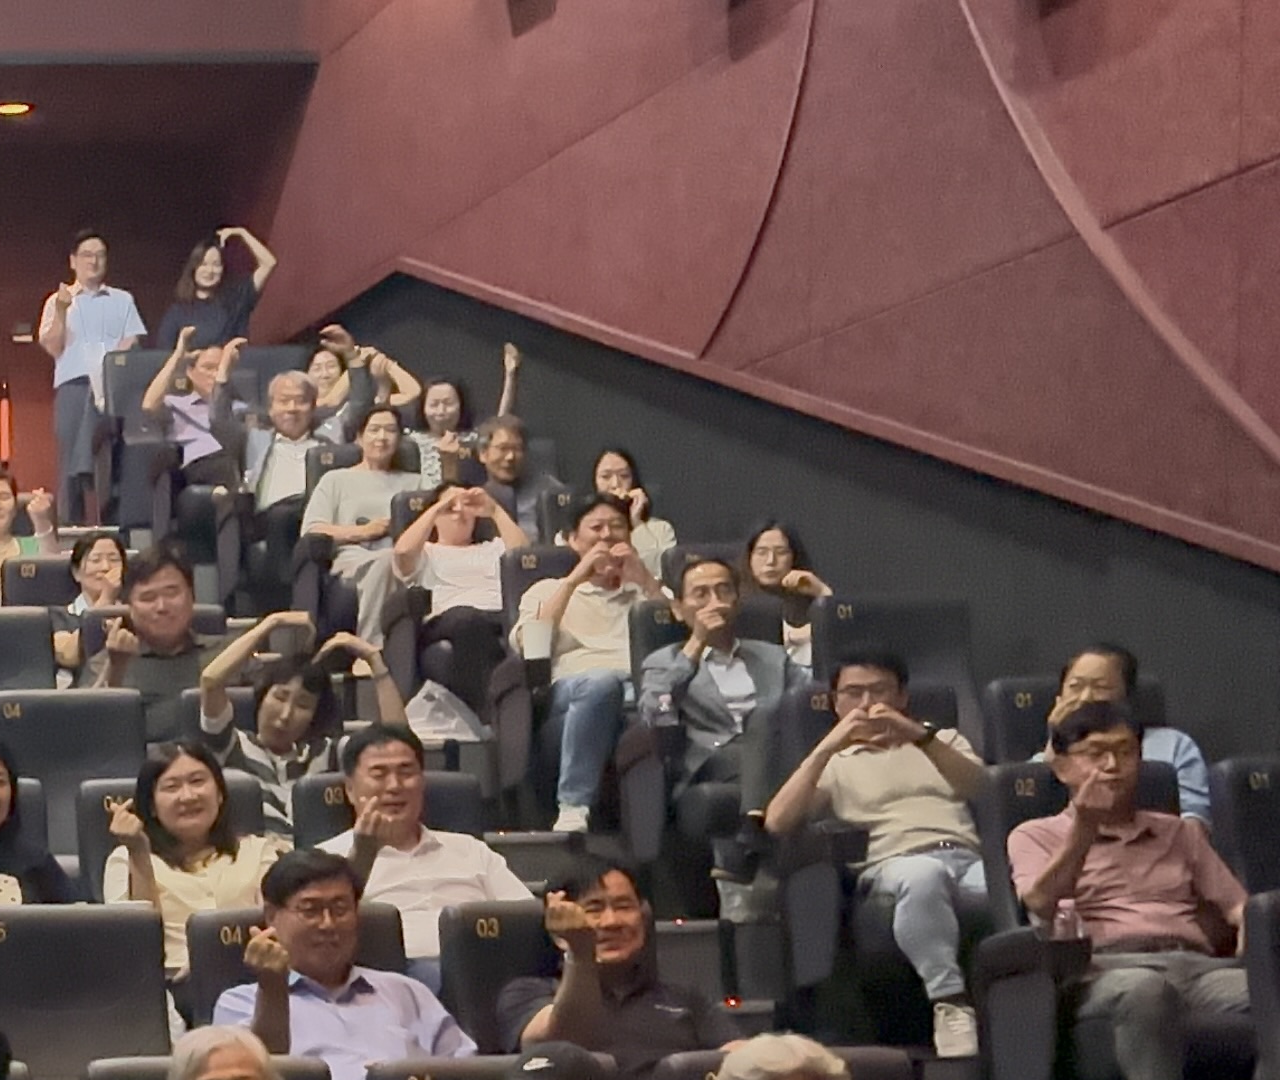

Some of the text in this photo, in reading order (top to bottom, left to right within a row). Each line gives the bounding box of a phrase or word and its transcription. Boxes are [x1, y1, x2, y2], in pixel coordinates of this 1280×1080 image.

[2, 701, 21, 719] 04
[1013, 777, 1036, 797] 02
[220, 924, 243, 945] 04
[475, 917, 500, 938] 03
